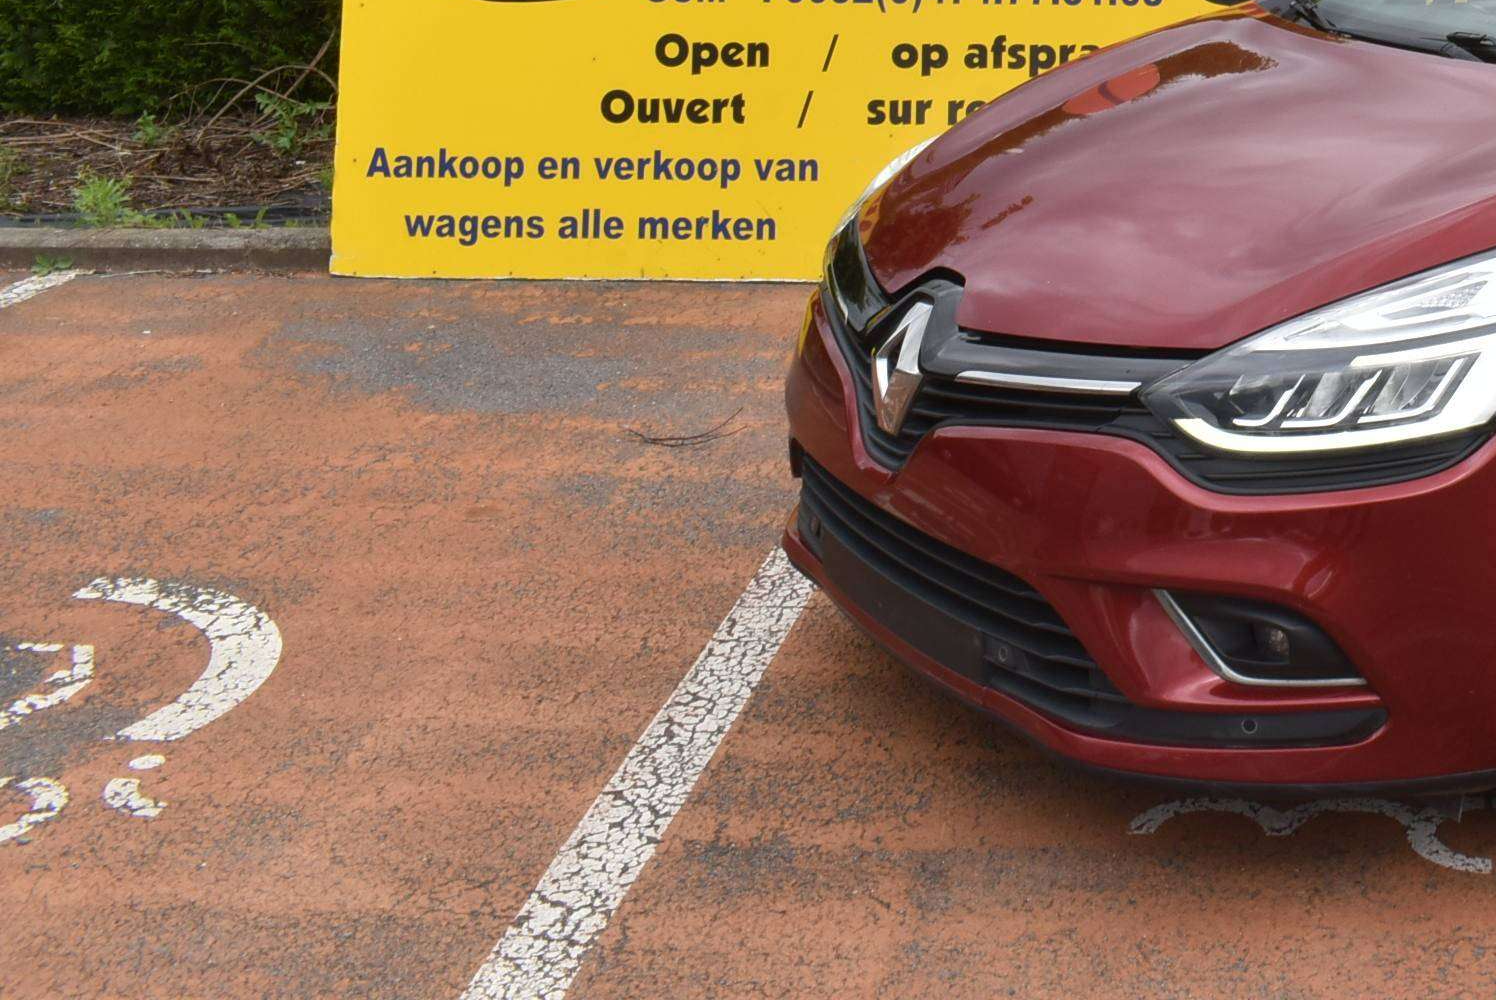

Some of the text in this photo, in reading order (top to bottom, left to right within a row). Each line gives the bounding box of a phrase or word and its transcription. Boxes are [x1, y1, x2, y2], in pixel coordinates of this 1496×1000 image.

[654, 33, 770, 76] Open
[822, 34, 839, 72] /
[891, 43, 949, 77] op
[600, 89, 746, 125] Ouvert
[797, 90, 814, 129] /
[867, 99, 933, 126] sur
[366, 147, 818, 189] Aankoop en verkoop van
[404, 208, 776, 247] wagens alle merken
